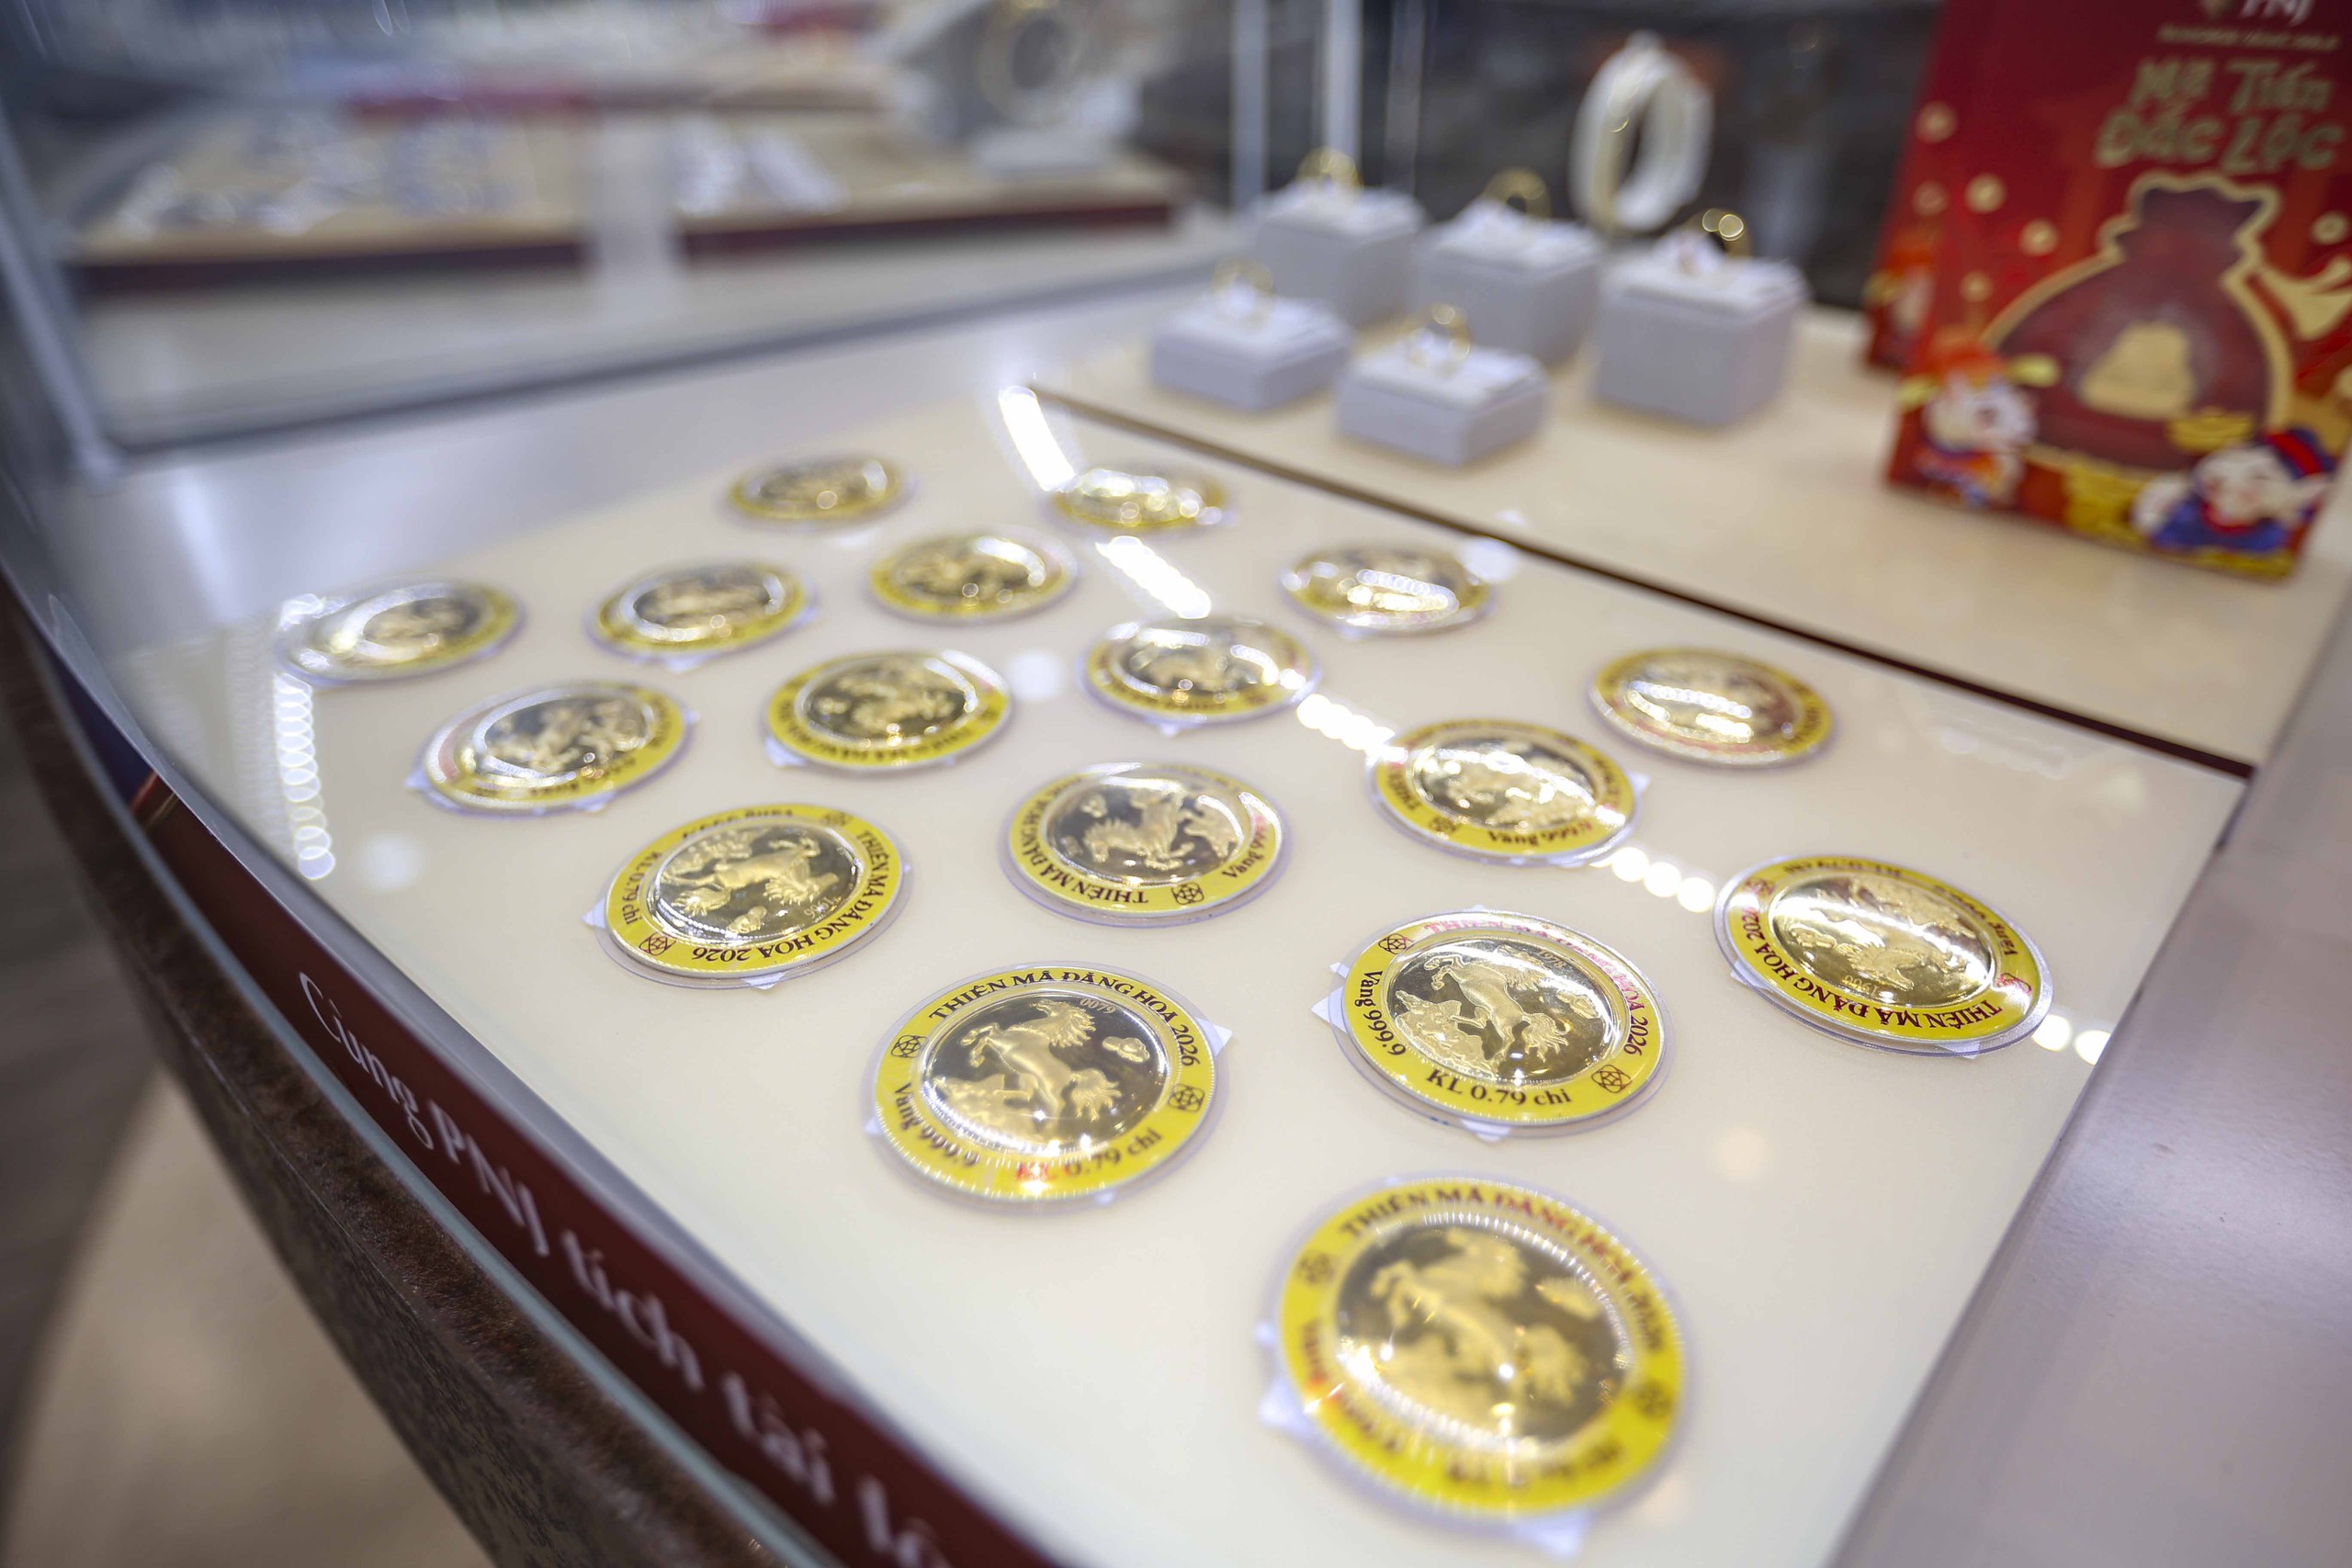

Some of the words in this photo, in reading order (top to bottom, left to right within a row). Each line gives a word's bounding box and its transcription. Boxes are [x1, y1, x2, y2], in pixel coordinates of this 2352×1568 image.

[815, 901, 874, 941] ĐĂNG
[692, 946, 752, 964] 2026
[757, 934, 816, 960] HOA
[1754, 945, 1797, 981] HOA
[1354, 970, 1383, 1007] Vàng
[1793, 978, 1870, 1020] ĐĂNG
[929, 979, 1008, 1021] THIÊN
[1061, 971, 1136, 996] ĐĂNG
[1130, 989, 1179, 1023] HOA
[1171, 1021, 1201, 1067] 2026
[1363, 1010, 1407, 1055] 999.9
[1922, 998, 2005, 1030] THIÊN
[1623, 1016, 1649, 1056] 2026
[1426, 1068, 1463, 1095] KL
[1471, 1085, 1527, 1106] 0.79
[429, 1099, 549, 1256] PNJ
[1065, 1146, 1121, 1179] 0.79
